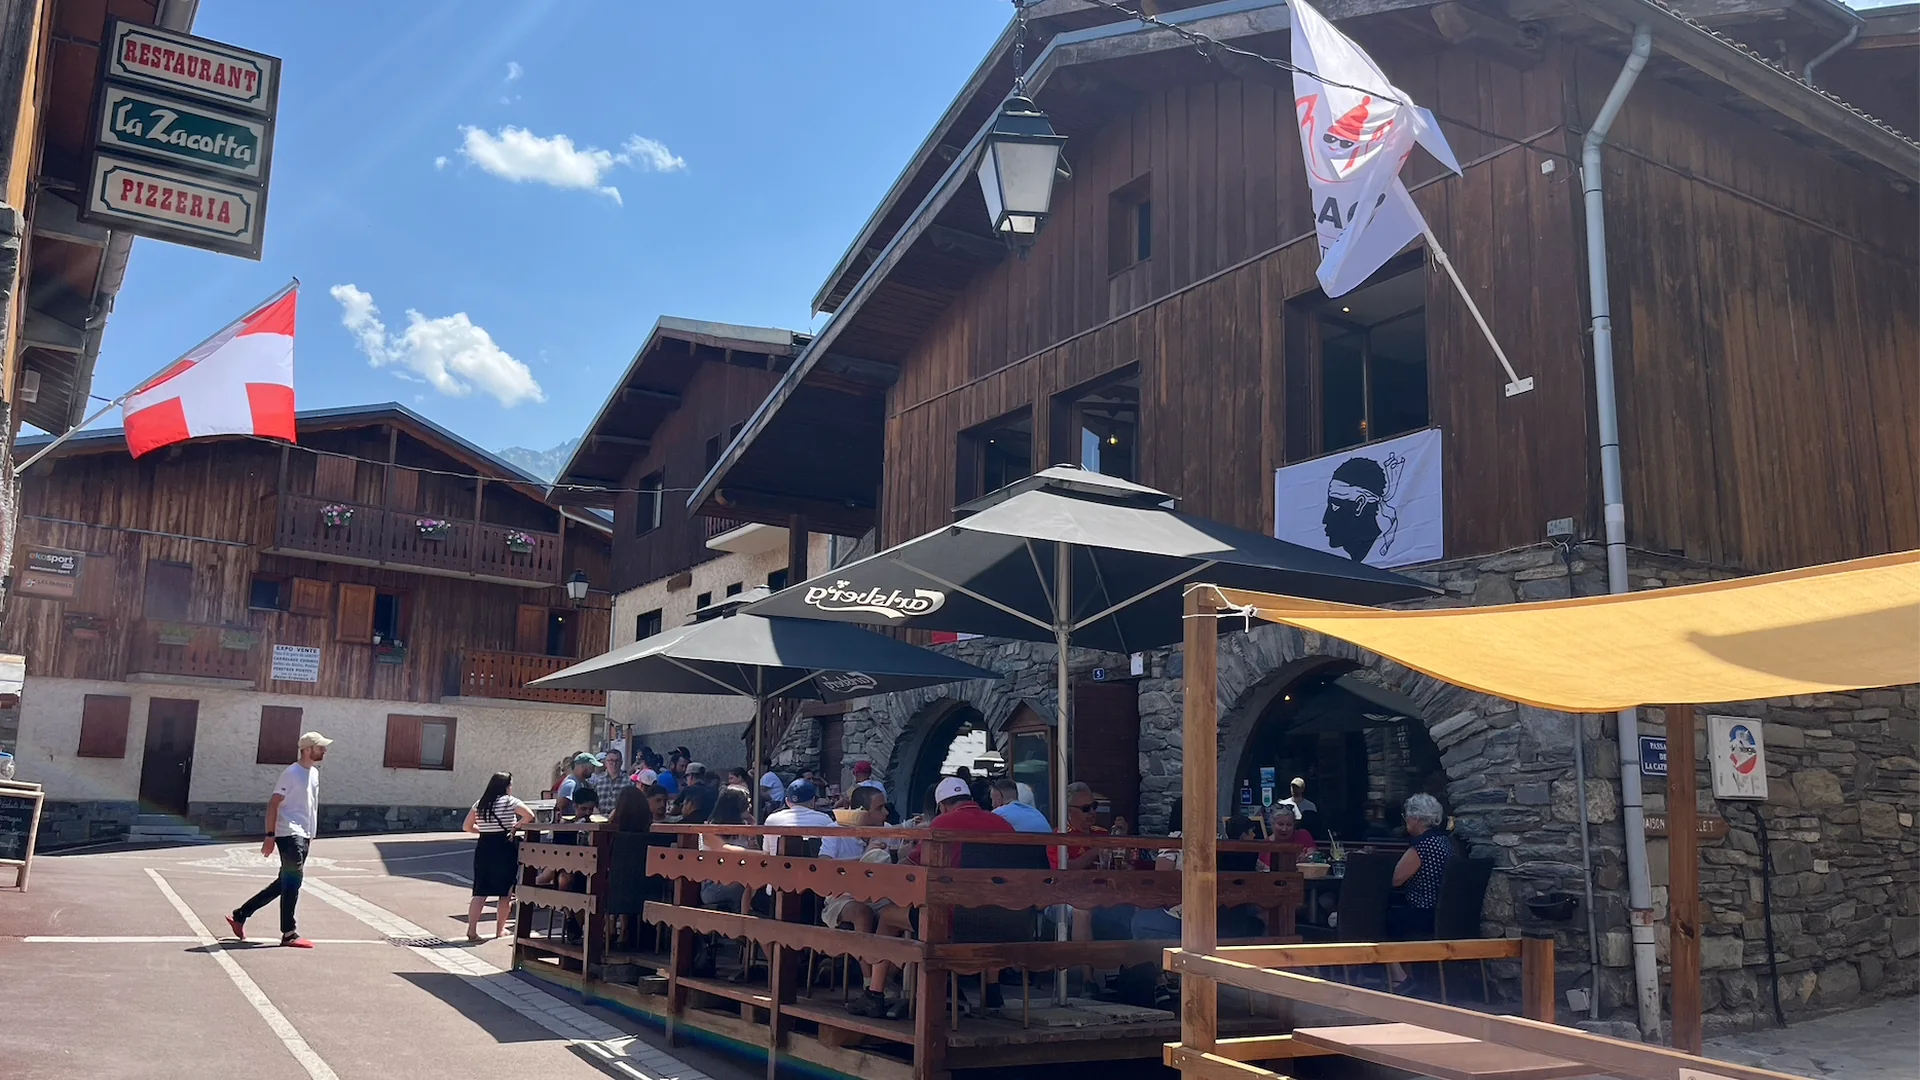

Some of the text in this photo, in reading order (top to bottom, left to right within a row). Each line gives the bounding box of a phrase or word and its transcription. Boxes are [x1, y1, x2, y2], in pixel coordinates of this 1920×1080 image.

[124, 39, 257, 92] RESTAURANT
[145, 109, 252, 162] Zacotta
[121, 178, 231, 224] PIZZERIA
[29, 552, 73, 563] ekosport
[1650, 742, 1667, 750] PASSA
